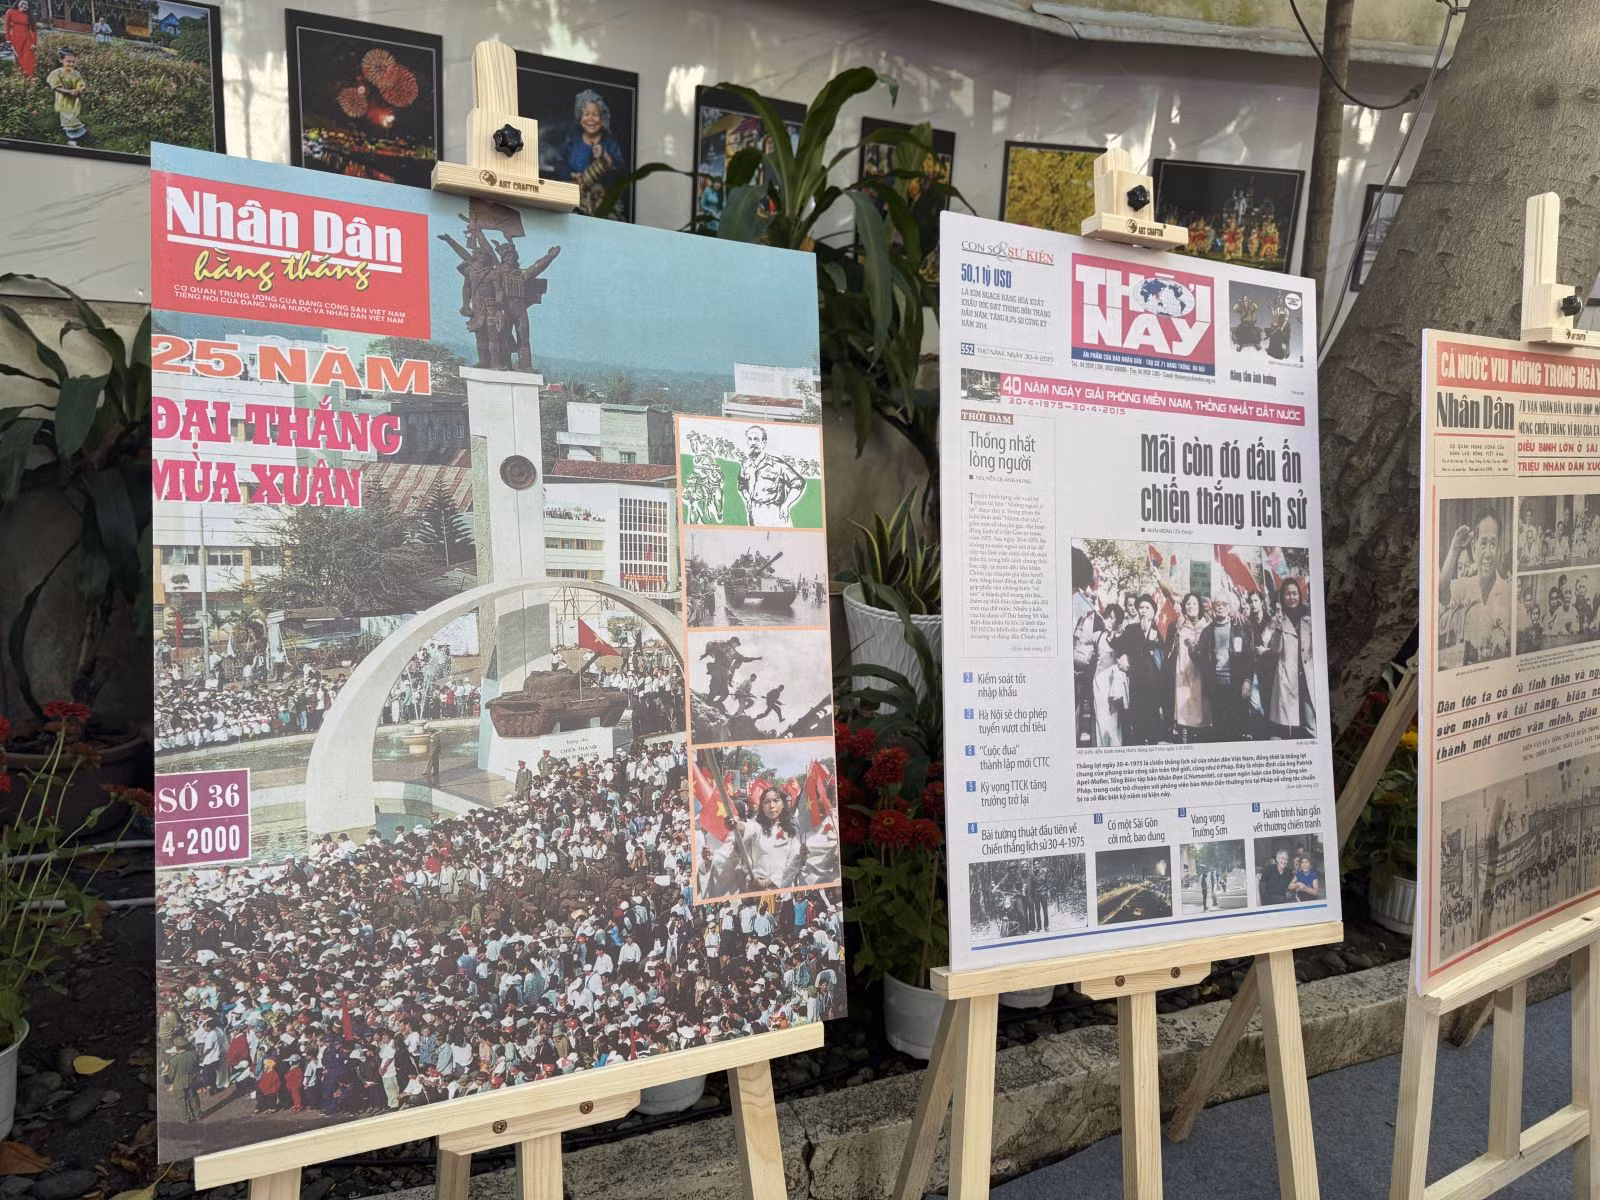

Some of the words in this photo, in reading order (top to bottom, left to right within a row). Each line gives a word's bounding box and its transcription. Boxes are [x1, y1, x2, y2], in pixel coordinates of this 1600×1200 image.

[499, 180, 510, 189] ART
[513, 182, 539, 192] CRAFTIN
[166, 186, 298, 248] Nhân
[314, 210, 402, 263] Dân
[1138, 227, 1146, 235] ART
[961, 240, 984, 252] CON
[193, 248, 276, 292] hằng
[281, 250, 370, 290] tháng
[961, 263, 979, 284] 50,1
[994, 268, 1012, 288] USD
[190, 286, 216, 296] QUAN
[219, 290, 250, 299] TRUNG
[1083, 303, 1211, 356] NAY
[961, 344, 974, 354] 552
[150, 334, 244, 379] 25
[257, 344, 432, 396] NĂM
[1441, 348, 1455, 379] CẢ
[1457, 352, 1489, 381] NƯỚC
[1490, 357, 1509, 383] VUI
[1511, 356, 1541, 386] MỪNG
[1544, 363, 1576, 389] TRONG
[1003, 376, 1022, 395] 40
[1024, 382, 1049, 394] NĂM
[1051, 384, 1081, 397] NGÀY
[1107, 388, 1140, 404] PHÓNG
[1143, 392, 1166, 407] MIỀN
[1169, 397, 1192, 411] NAM,
[1195, 398, 1227, 413] THỐNG
[1229, 402, 1253, 416] NHẤT
[1256, 404, 1275, 417] ĐẤT
[962, 410, 986, 421] THỜI
[989, 412, 1011, 423] ĐÀM
[1436, 392, 1480, 429] Nhân
[1483, 395, 1514, 430] Dân
[152, 396, 234, 450] ĐẠI
[245, 394, 402, 456] THẮNG
[969, 430, 1006, 454] Thống
[1009, 434, 1035, 452] nhất
[970, 450, 995, 473] lòng
[999, 454, 1031, 474] người
[1141, 433, 1175, 474] Mãi
[1183, 436, 1213, 477] còn
[1220, 440, 1240, 479] đó
[1247, 436, 1276, 481] dấu
[1282, 438, 1302, 484] ấn
[152, 450, 243, 504] MÙA
[250, 458, 363, 508] XUÂN
[1141, 477, 1190, 524] chiến
[1196, 480, 1245, 529] thắng
[1251, 490, 1281, 536] lịch
[1287, 489, 1308, 530] sử
[977, 672, 996, 684] Kiểm
[998, 673, 1014, 684] soát
[1015, 672, 1026, 683] tốt
[978, 687, 997, 700] nhập
[999, 685, 1017, 697] khẩu
[1437, 700, 1455, 714] Dân
[1462, 695, 1477, 709] tộc
[1482, 692, 1491, 702] ta
[1497, 687, 1507, 698] có
[1512, 683, 1524, 694] đủ
[1551, 672, 1570, 686] thần
[1574, 669, 1585, 681] và
[978, 709, 988, 720] Hà
[990, 709, 1002, 721] Nội
[1005, 709, 1012, 720] sẽ
[1014, 708, 1027, 719] cho
[1029, 708, 1047, 721] phép
[1436, 722, 1456, 737] sức
[1462, 714, 1491, 731] mạnh
[1497, 709, 1508, 720] và
[979, 721, 1000, 736] tuyển
[1001, 723, 1018, 735] vượt
[1020, 721, 1031, 732] chỉ
[1033, 721, 1046, 731] tiêu
[1436, 744, 1466, 761] thành
[1473, 735, 1491, 750] một
[1497, 728, 1522, 742] nước
[1527, 721, 1544, 733] văn
[1579, 707, 1597, 721] giàu
[980, 759, 1002, 770] thành
[1004, 758, 1015, 771] lập
[1017, 758, 1031, 768] mới
[1033, 757, 1050, 768] CTTC
[159, 779, 198, 813] SỐ
[208, 783, 240, 809] 36
[981, 781, 990, 795] Kỳ
[992, 783, 1010, 794] vọng
[1010, 780, 1028, 791] TTCK
[1030, 780, 1046, 792] tăng
[981, 795, 1006, 808] trưởng
[1008, 794, 1019, 805] trở
[1021, 793, 1029, 806] lại
[1191, 813, 1208, 826] Vang
[1209, 812, 1225, 824] vọng
[1263, 808, 1279, 819] Hành
[1280, 806, 1295, 817] trình
[1296, 806, 1308, 816] hàn
[1308, 805, 1321, 817] gắn
[981, 828, 994, 840] Bài
[995, 828, 1016, 842] tường
[1018, 826, 1037, 838] thuật
[1039, 825, 1053, 836] đầu
[1054, 823, 1068, 835] tiên
[1069, 821, 1078, 834] về
[1107, 819, 1116, 830] Có
[1118, 818, 1132, 830] một
[1133, 817, 1143, 828] Sài
[1144, 816, 1158, 828] Gòn
[1192, 826, 1215, 839] Trường
[1216, 826, 1228, 836] Sơn
[1253, 822, 1264, 833] vết
[1264, 820, 1286, 832] thương
[1287, 819, 1304, 830] chiến
[1304, 818, 1321, 828] tranh
[162, 825, 240, 857] 4-2000
[982, 841, 1002, 855] Chiến
[1004, 839, 1025, 854] thắng
[1026, 839, 1038, 852] lịch
[1039, 837, 1048, 851] sử
[1048, 837, 1085, 850] 30-4-1975
[1108, 833, 1119, 845] cởi
[1133, 832, 1146, 842] bao
[1149, 830, 1165, 843] dung
